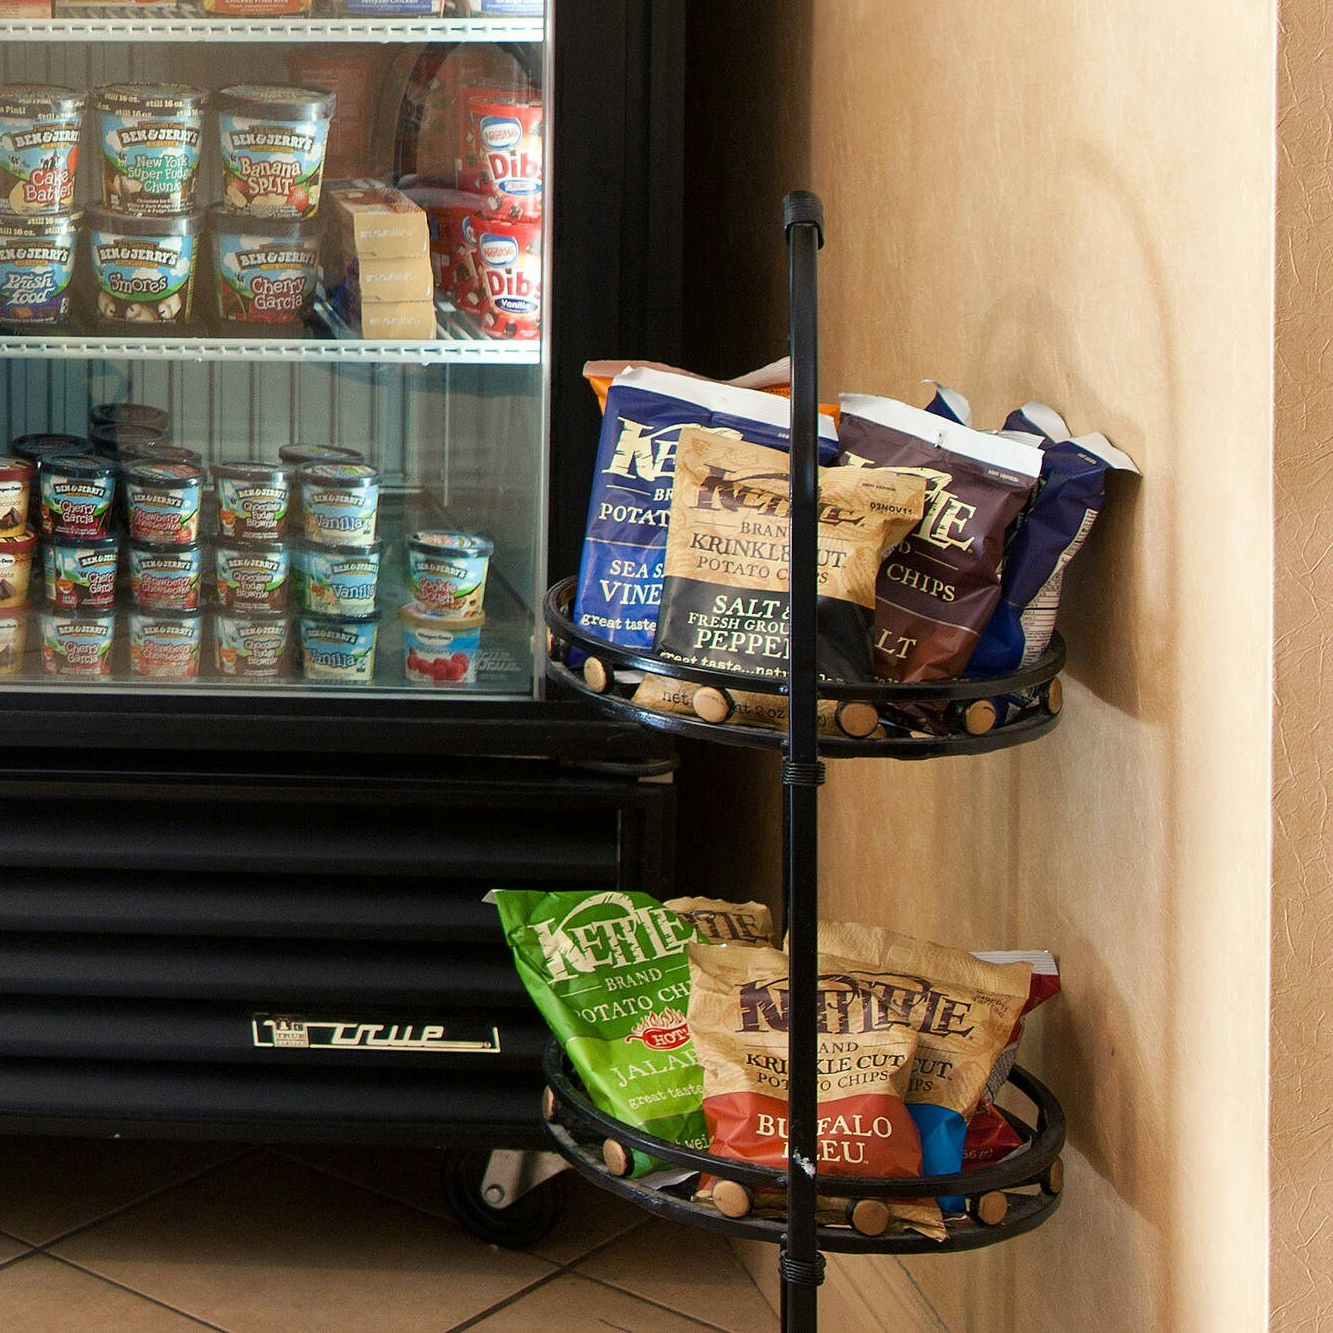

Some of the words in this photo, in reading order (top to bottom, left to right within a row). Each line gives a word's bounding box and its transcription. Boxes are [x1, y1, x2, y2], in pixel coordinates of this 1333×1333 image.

[136, 155, 162, 168] New
[240, 157, 302, 177] Banana
[31, 169, 69, 187] Cake
[251, 276, 306, 297] Cherry
[253, 294, 304, 311] Garcia
[609, 559, 649, 578] SEA
[697, 556, 770, 579] POTATO
[886, 563, 956, 603] CHIPS
[712, 595, 781, 619] SALT
[580, 611, 622, 629] great
[625, 617, 657, 633] taste
[687, 611, 741, 630] FRESH
[527, 891, 698, 984] KETTLE
[605, 967, 663, 992] BRAND
[838, 1070, 889, 1088] CHIPS
[628, 1091, 666, 1109] great
[668, 1084, 703, 1098] taste
